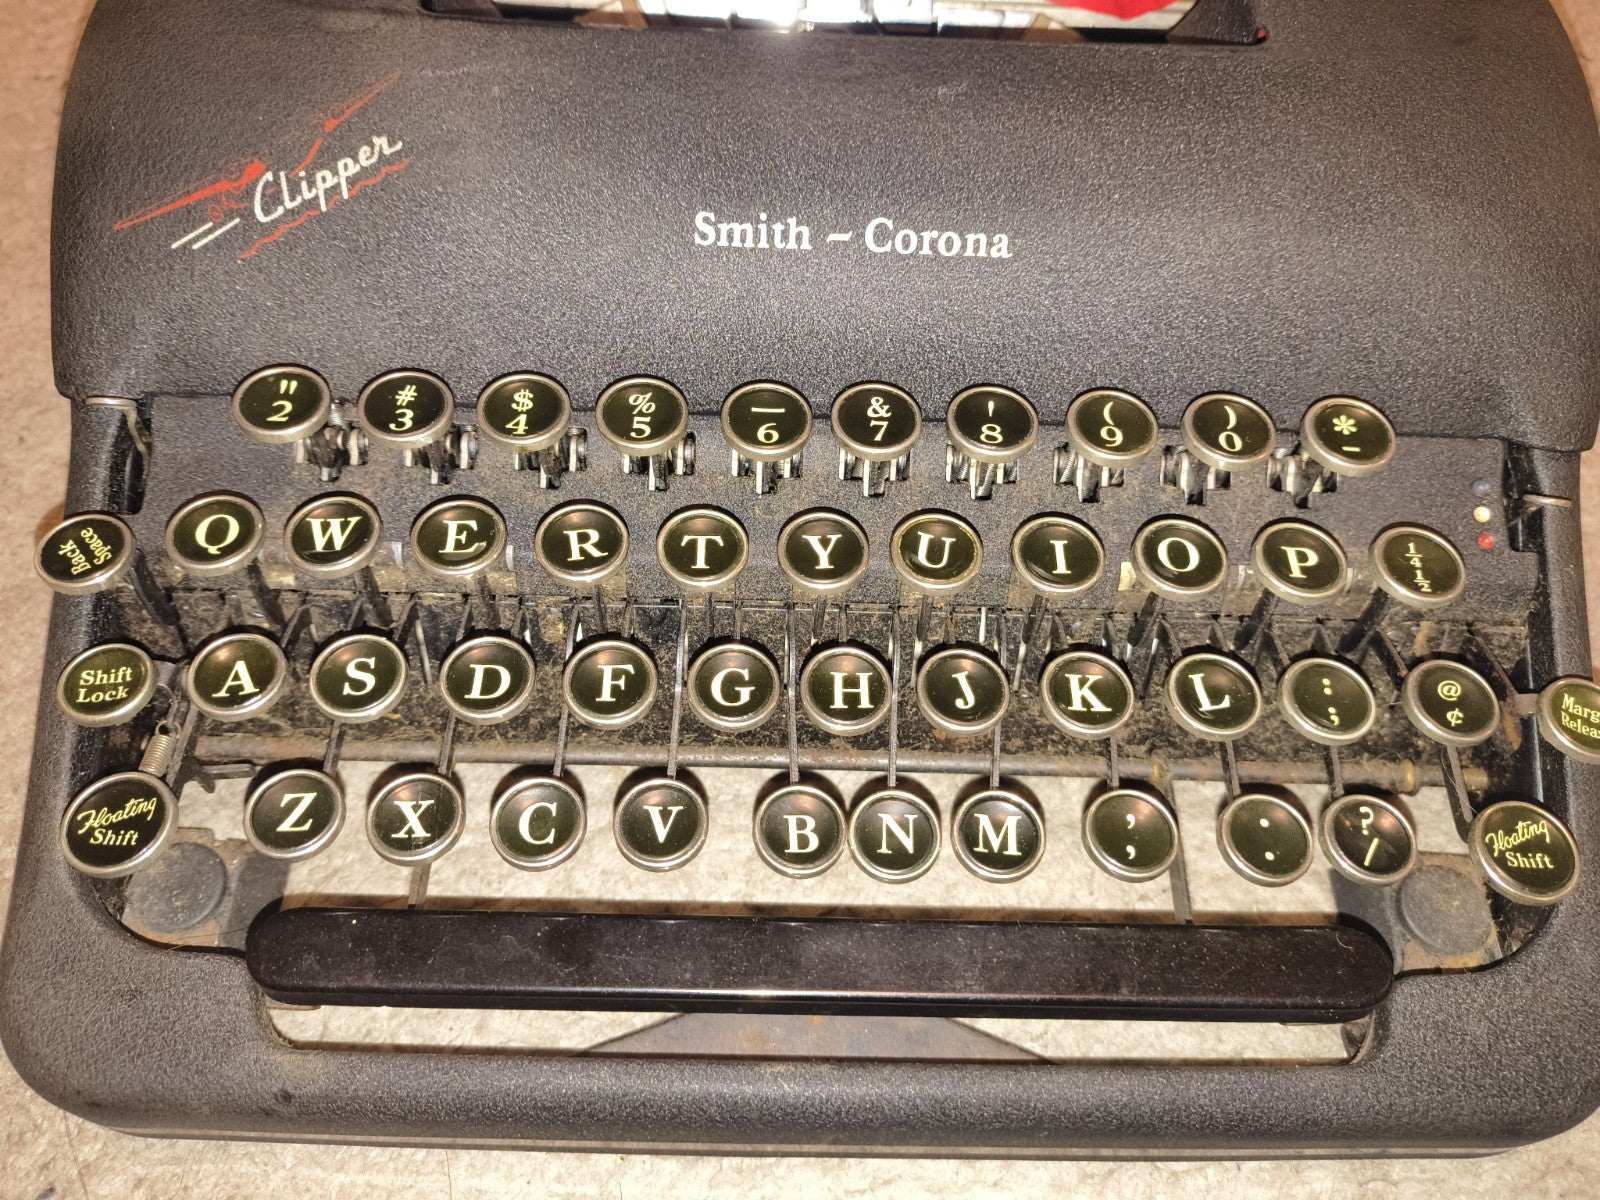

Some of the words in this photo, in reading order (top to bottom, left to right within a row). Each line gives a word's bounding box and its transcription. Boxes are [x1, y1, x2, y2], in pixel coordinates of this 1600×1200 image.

[254, 136, 403, 222] Clipper
[694, 211, 813, 250] Smith
[864, 217, 1012, 259] Corona
[267, 401, 292, 421] 2
[396, 385, 417, 406] #
[512, 389, 533, 412] $
[629, 393, 655, 414] %
[867, 397, 891, 417] &
[389, 409, 413, 430] 3
[506, 414, 529, 435] 4
[630, 417, 651, 438] 5
[870, 420, 888, 441] 7
[1104, 402, 1114, 425] (
[1224, 406, 1236, 429] )
[757, 423, 779, 443] 6
[980, 424, 1003, 444] 8
[1100, 426, 1123, 447] 9
[80, 527, 112, 565] Space
[195, 514, 240, 554] Q
[308, 517, 362, 552] W
[444, 519, 487, 554] E
[563, 529, 608, 561] R
[917, 531, 956, 568] U
[58, 539, 92, 575] Back
[681, 535, 723, 568] T
[802, 534, 842, 569] Y
[1050, 540, 1071, 573] I
[1158, 537, 1199, 571] O
[1281, 546, 1318, 578] P
[80, 667, 132, 689] Shift
[212, 660, 260, 699] A
[343, 656, 376, 696] S
[465, 664, 510, 699] D
[596, 664, 635, 702] F
[711, 667, 755, 706] G
[830, 671, 875, 709] H
[952, 671, 976, 709] J
[1065, 673, 1113, 712] K
[1189, 673, 1230, 711] L
[1438, 680, 1461, 700] @
[76, 686, 128, 704] Lock
[1328, 707, 1339, 725] ;
[1447, 708, 1463, 726] ¢
[76, 796, 157, 834] Floating
[276, 792, 317, 831] Z
[392, 799, 432, 838] X
[518, 801, 557, 845] C
[643, 805, 683, 843] V
[1360, 806, 1374, 835] ?
[90, 829, 138, 845] Shift
[783, 815, 819, 853] B
[877, 813, 915, 854] N
[974, 814, 1022, 855] M
[1485, 818, 1550, 857] Floating
[1364, 838, 1379, 866] /
[1506, 852, 1553, 868] Shift
